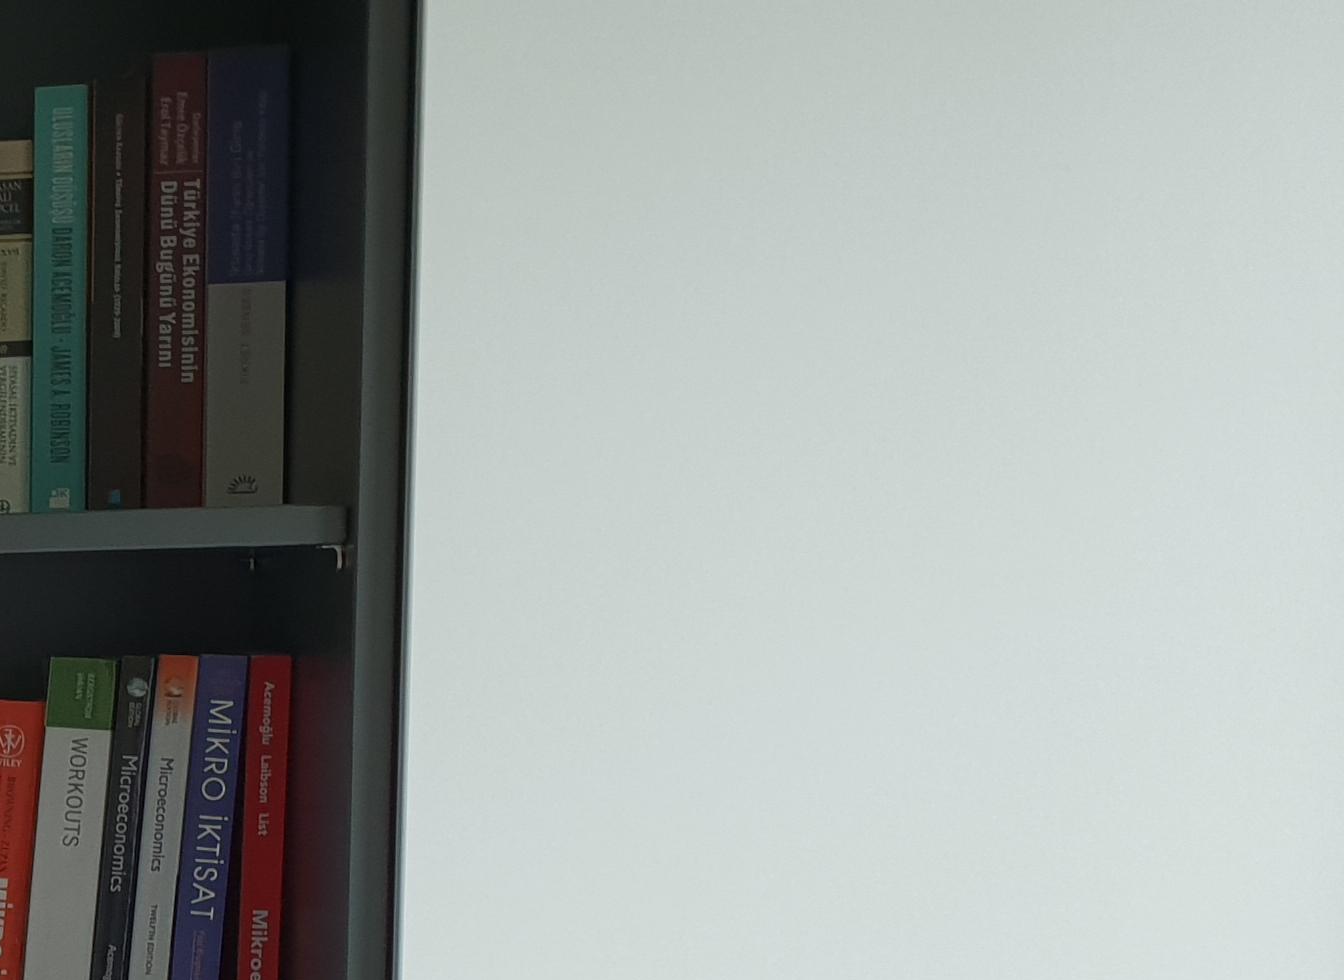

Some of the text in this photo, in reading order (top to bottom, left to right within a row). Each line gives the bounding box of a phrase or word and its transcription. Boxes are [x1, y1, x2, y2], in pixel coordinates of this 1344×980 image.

[49, 226, 76, 334] DARON ACEMOĞLU
[155, 180, 178, 367] Dünü Bugünü Yarını
[178, 178, 200, 383] Türkiye Ekonomisinin
[48, 345, 71, 463] JAMES ROBINSON
[61, 736, 89, 848] WORKOUTS
[199, 697, 240, 802] MİKRO
[255, 681, 275, 836] Acemoğlu Laibson List
[108, 753, 139, 893] Microeconomics
[149, 756, 174, 873] Microeconomics
[188, 813, 229, 921] İKTİSAT
